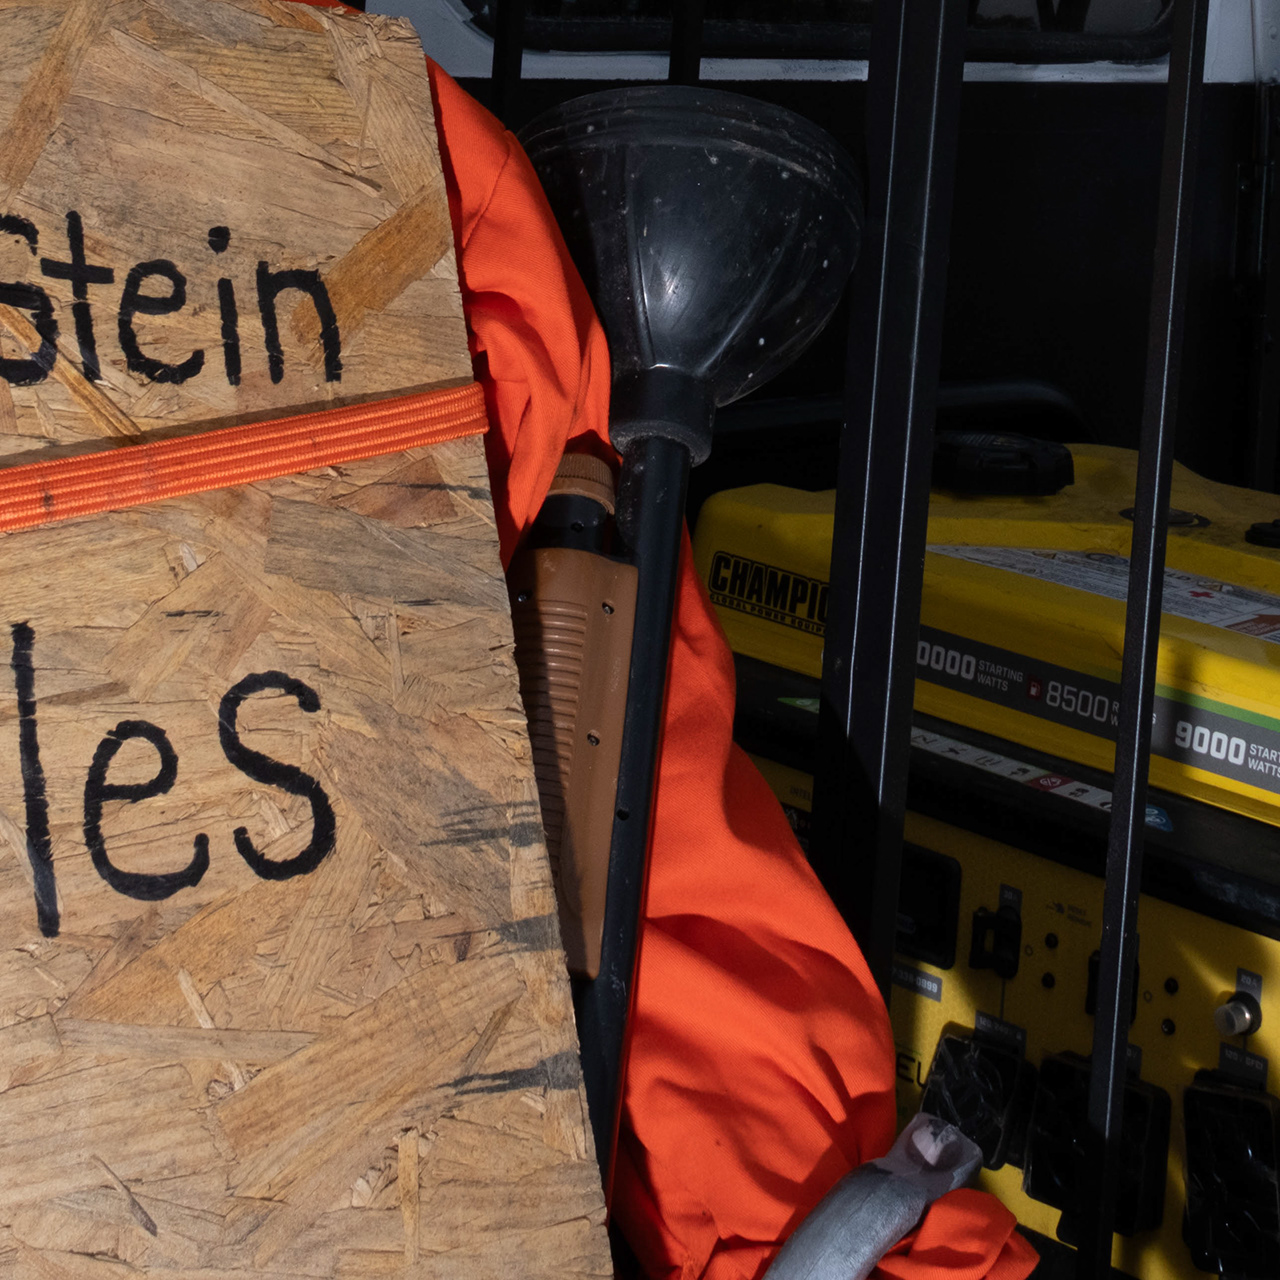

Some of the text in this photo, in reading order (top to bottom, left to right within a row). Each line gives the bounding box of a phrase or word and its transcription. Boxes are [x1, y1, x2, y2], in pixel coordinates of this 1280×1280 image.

[711, 554, 830, 623] CHAMPIO
[790, 615, 826, 634] EQUIP
[916, 640, 977, 681] 0000
[978, 659, 1025, 683] STARTING
[1046, 680, 1110, 723] 8500
[976, 672, 1009, 692] WATTS
[1174, 720, 1247, 766] 9000
